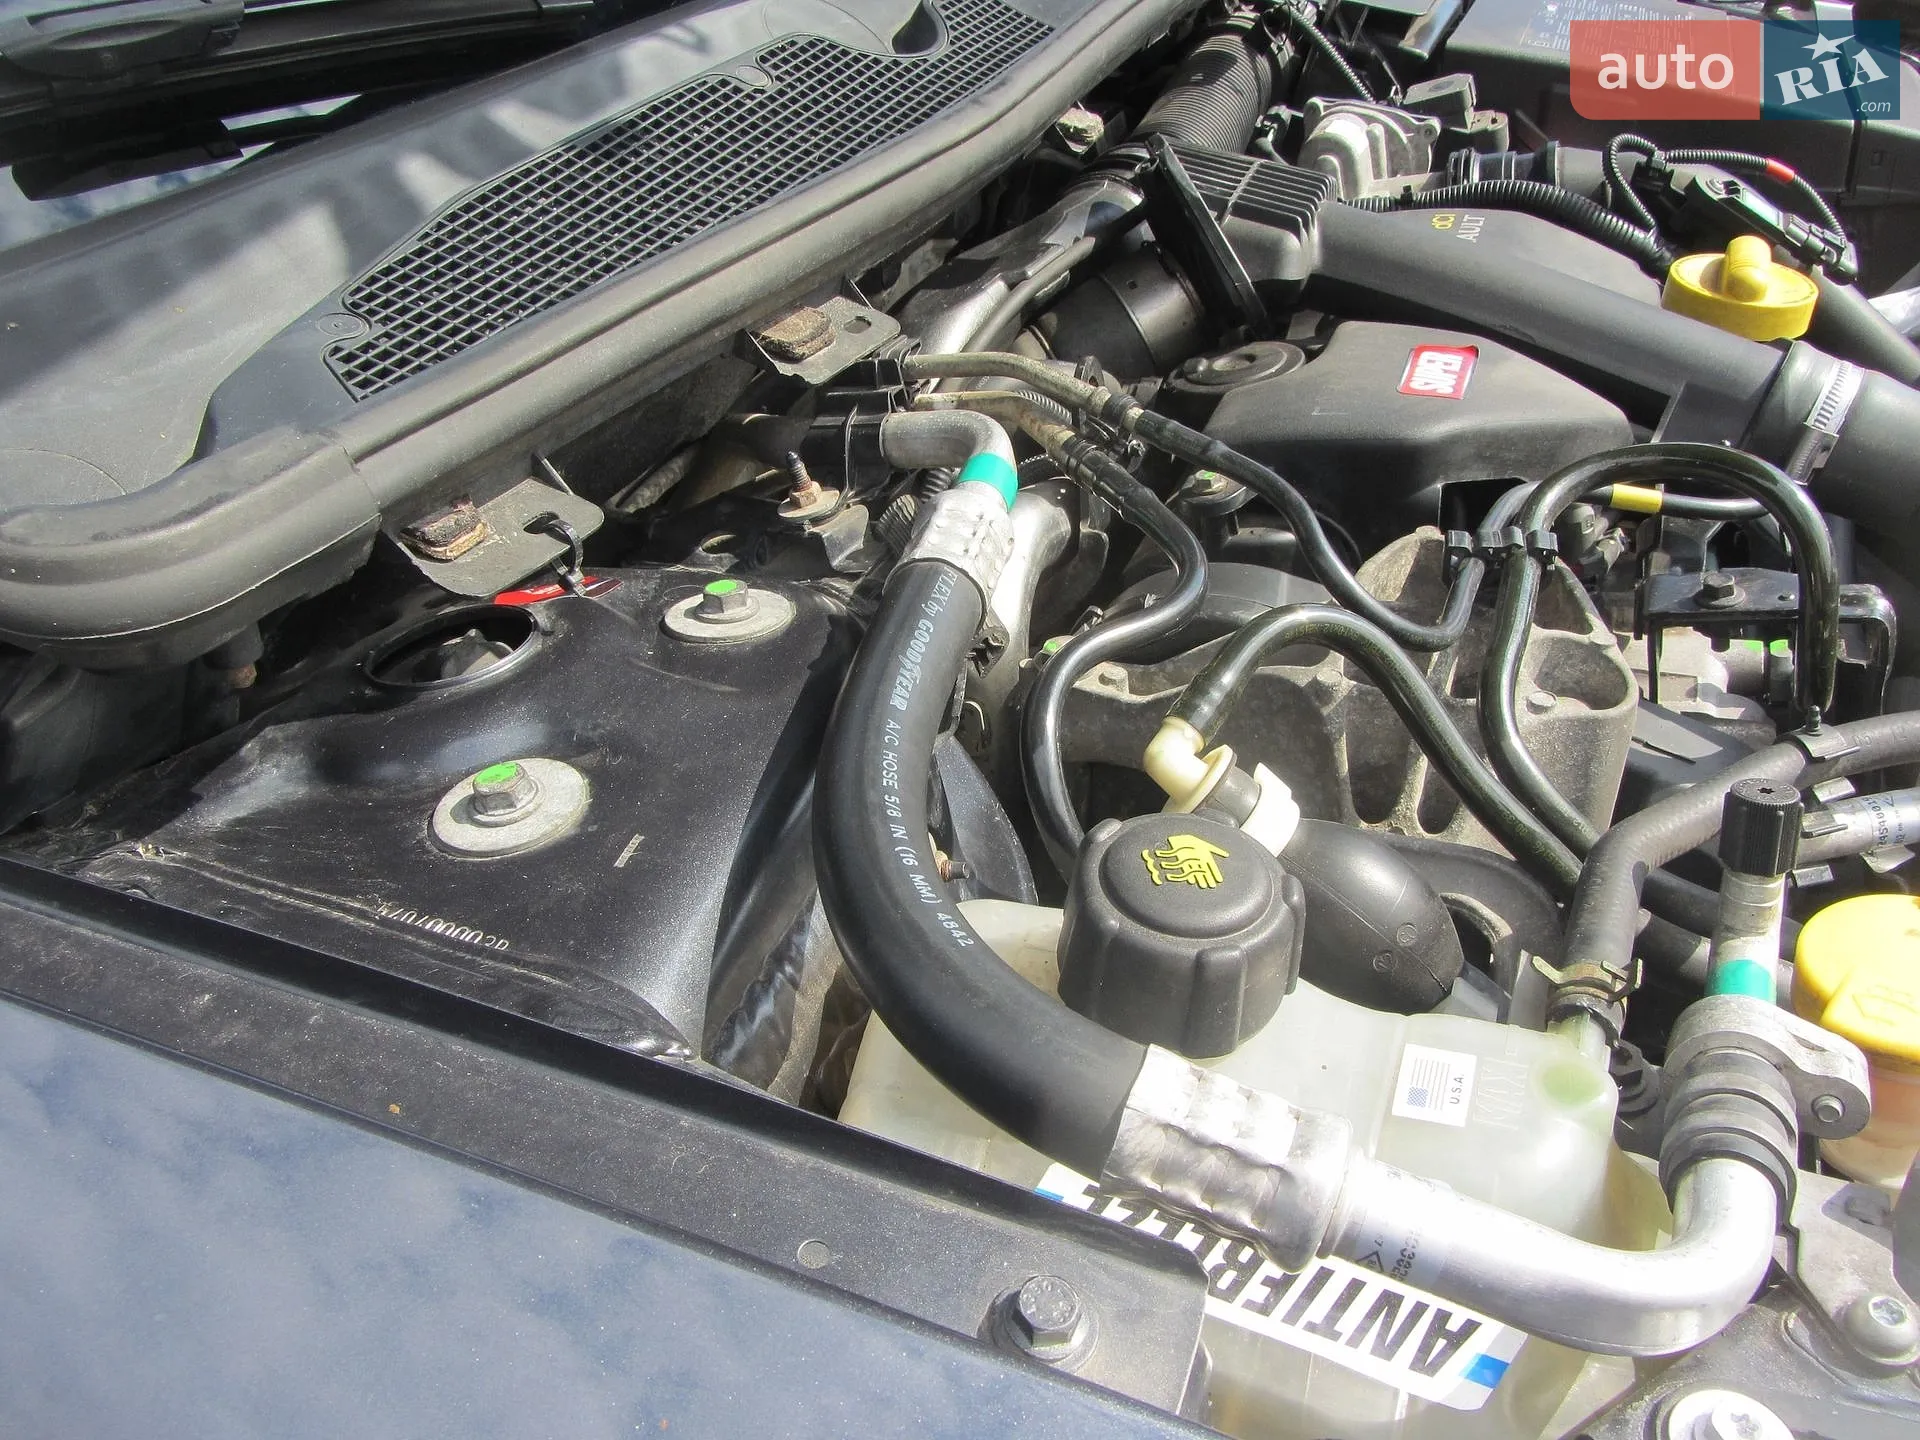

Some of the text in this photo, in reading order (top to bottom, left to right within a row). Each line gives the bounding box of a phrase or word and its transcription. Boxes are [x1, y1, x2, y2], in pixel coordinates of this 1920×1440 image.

[890, 618, 934, 712] GOODYEAR
[884, 718, 902, 747] A/C
[881, 749, 899, 788] HOSE
[884, 793, 901, 818] 5/8
[889, 823, 908, 840] IN
[893, 845, 919, 867] (16
[908, 872, 943, 905] MM)
[1449, 1073, 1466, 1106] U.S.A.
